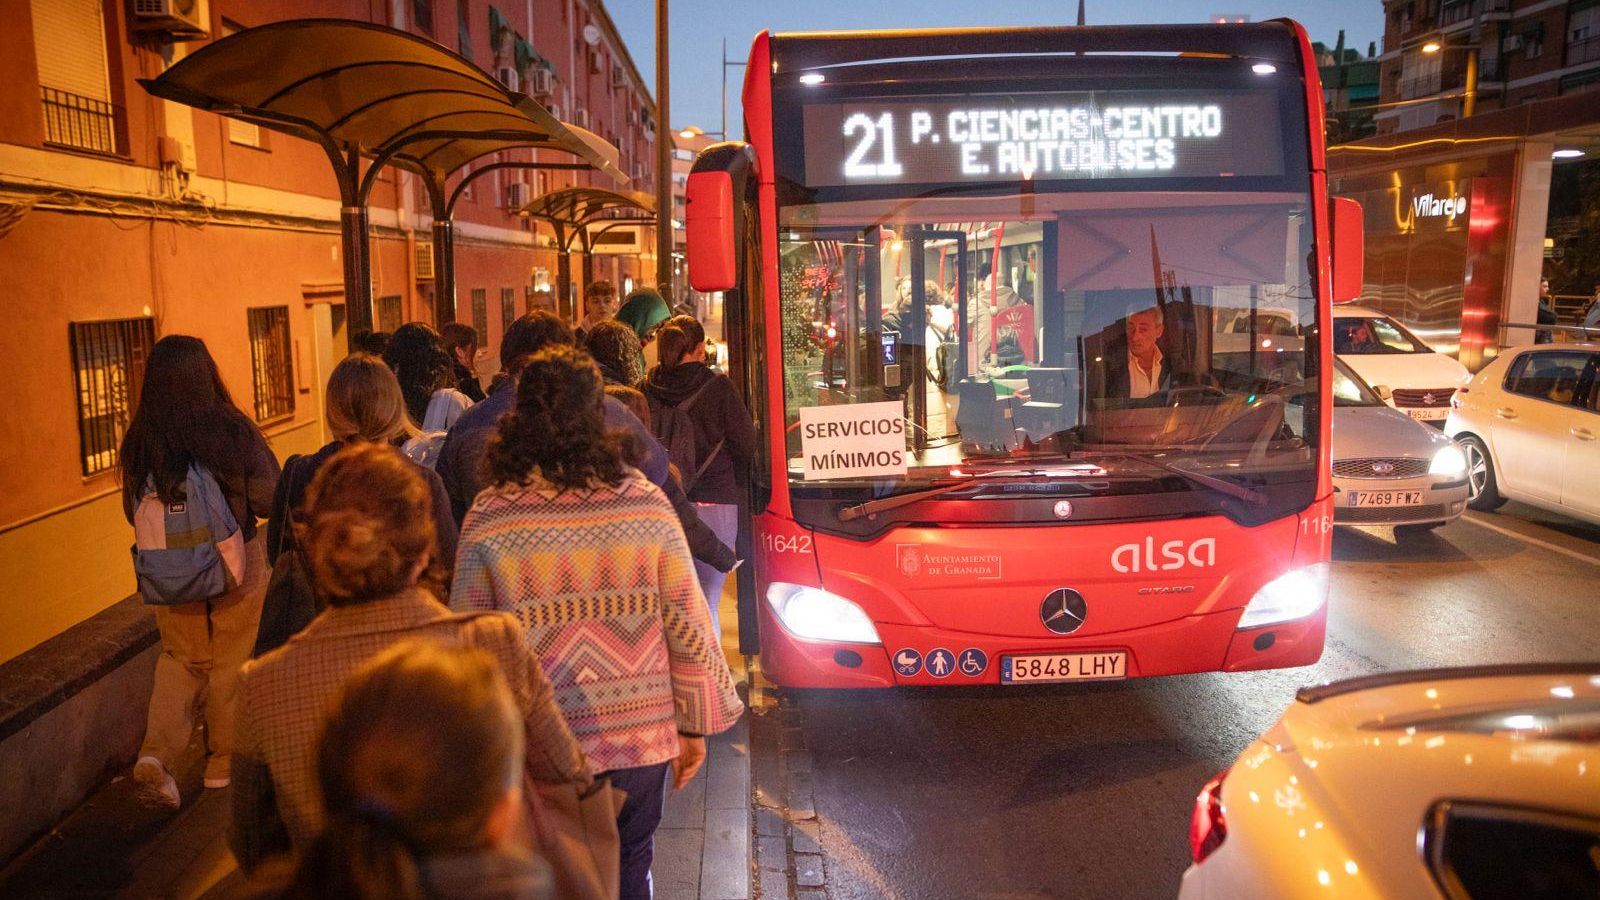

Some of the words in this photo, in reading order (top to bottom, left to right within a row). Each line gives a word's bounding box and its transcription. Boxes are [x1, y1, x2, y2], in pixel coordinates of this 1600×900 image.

[911, 111, 940, 144] P.
[948, 105, 1223, 143] CIENCIAS-CENTRO
[843, 111, 903, 178] 21
[961, 142, 989, 175] E.
[997, 138, 1175, 174] AUTOBUSES
[1413, 192, 1467, 220] Villarejo
[1412, 410, 1433, 419] 9524
[805, 417, 904, 439] SERVICIOS
[810, 448, 902, 471] MÍNIMOS
[1359, 492, 1392, 506] 7469
[1396, 491, 1421, 504] FWZ
[760, 531, 812, 554] 11642
[923, 553, 1000, 564] AYUNTAMIENTO
[1110, 535, 1216, 574] alsa
[944, 564, 991, 575] GRANADA
[1137, 585, 1195, 596] CITARO
[1015, 657, 1070, 679] 5848
[1079, 655, 1120, 676] LHY
